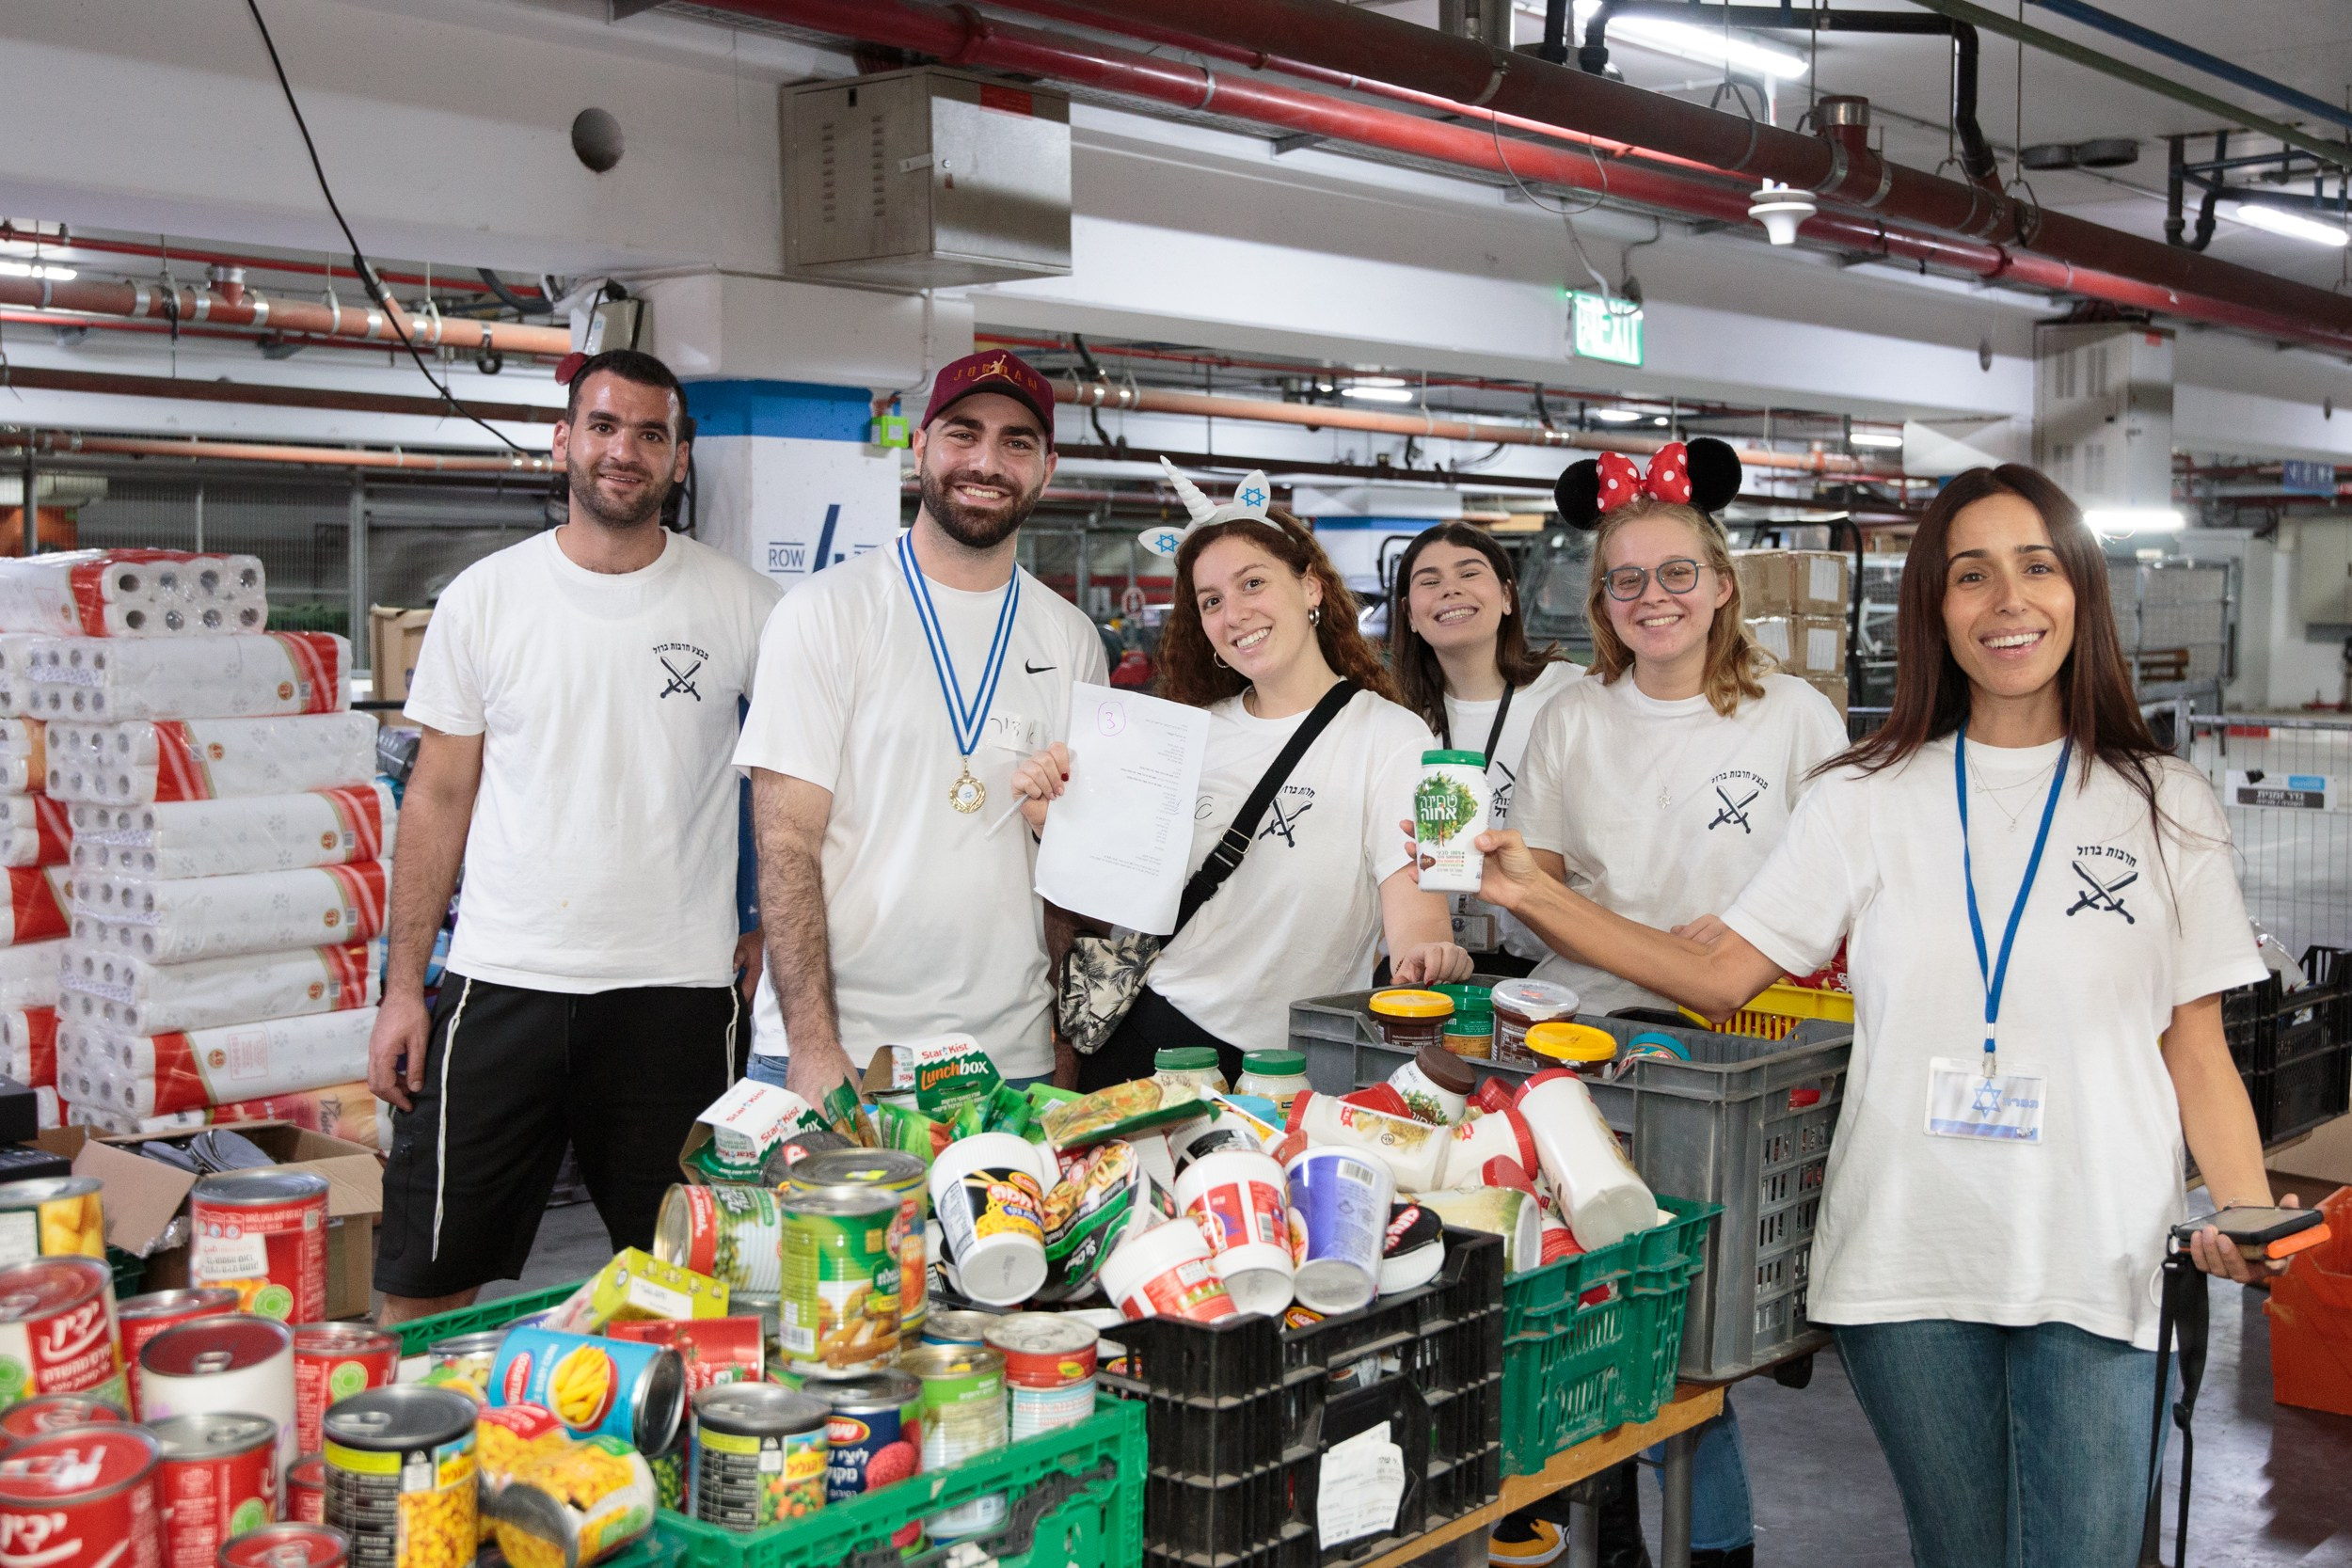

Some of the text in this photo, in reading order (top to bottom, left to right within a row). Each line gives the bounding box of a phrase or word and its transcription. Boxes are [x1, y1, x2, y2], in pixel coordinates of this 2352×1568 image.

[769, 549, 805, 567] ROW
[653, 642, 709, 660] מבצע חרבות ברזל
[1104, 711, 1116, 730] 3
[1711, 770, 1769, 790] מבצע חרבות ברזל
[1420, 795, 1458, 809] טחינה
[1421, 806, 1457, 821] אחוה
[2076, 846, 2137, 867] חרבות ברזל
[921, 1041, 970, 1060] Star Kist
[921, 1057, 990, 1091] Lunchbox
[726, 1088, 768, 1123] Star Kist
[760, 1105, 801, 1144] Star Kist
[509, 1352, 532, 1406] WILLIFOOD
